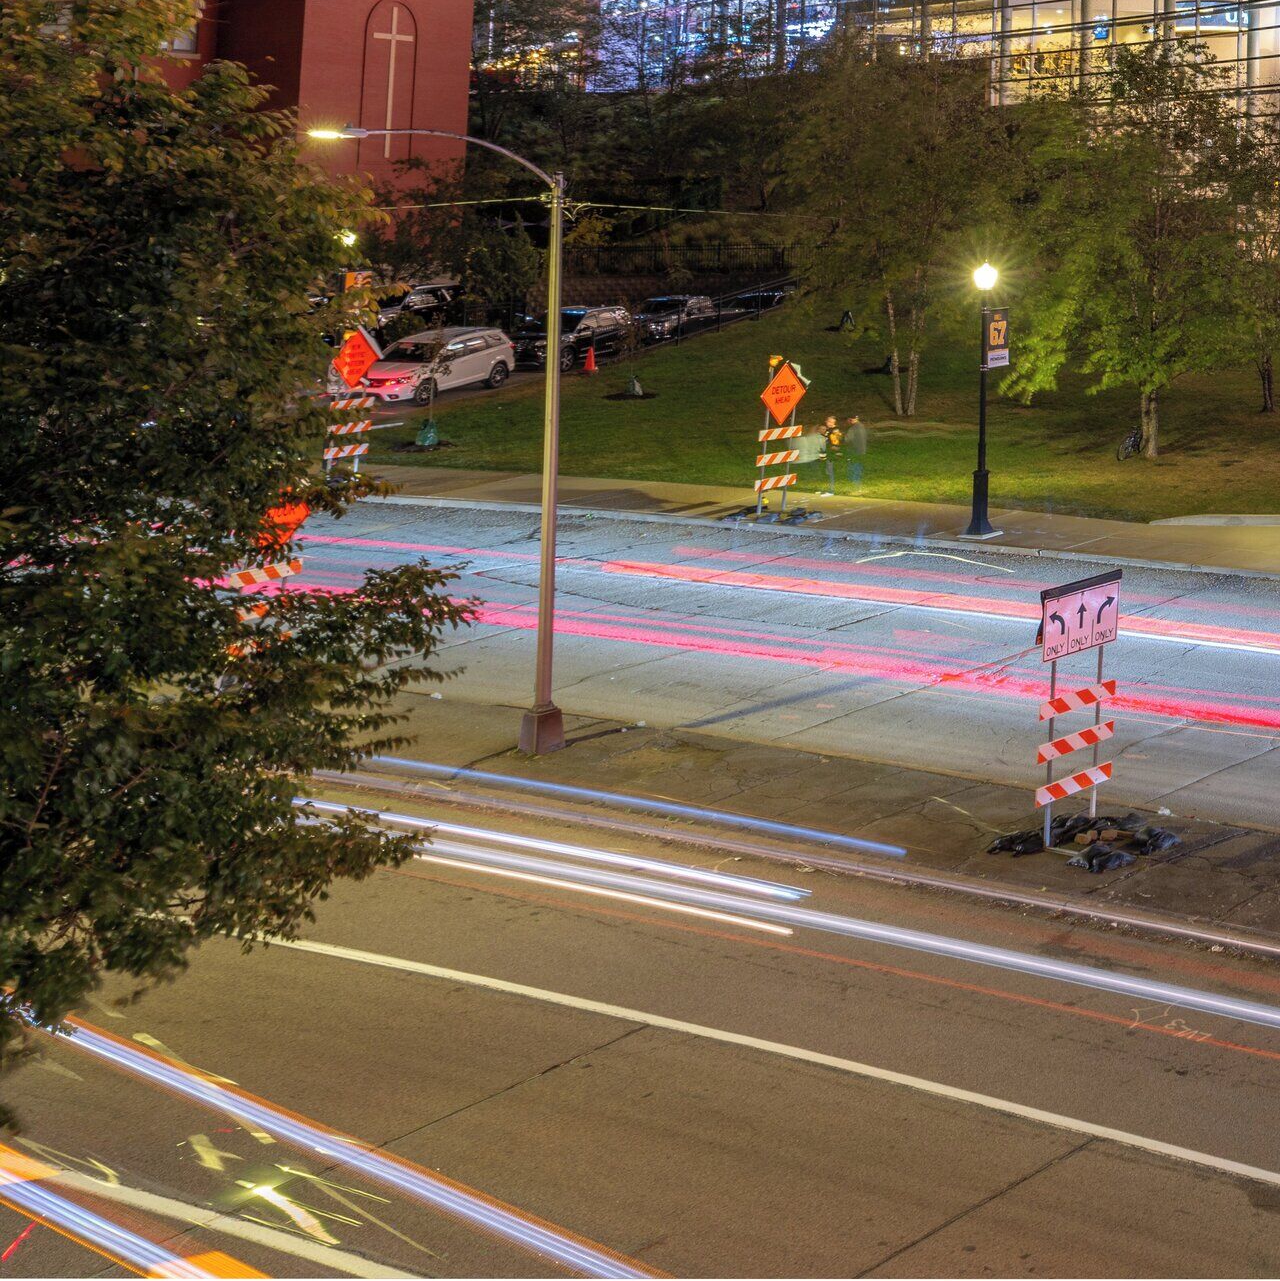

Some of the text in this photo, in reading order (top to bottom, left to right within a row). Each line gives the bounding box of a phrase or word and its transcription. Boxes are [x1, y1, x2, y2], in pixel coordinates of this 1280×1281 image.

[989, 321, 1006, 345] 67
[771, 384, 796, 395] DETOUR
[1046, 627, 1114, 657] ONLY ONLY ONLY
